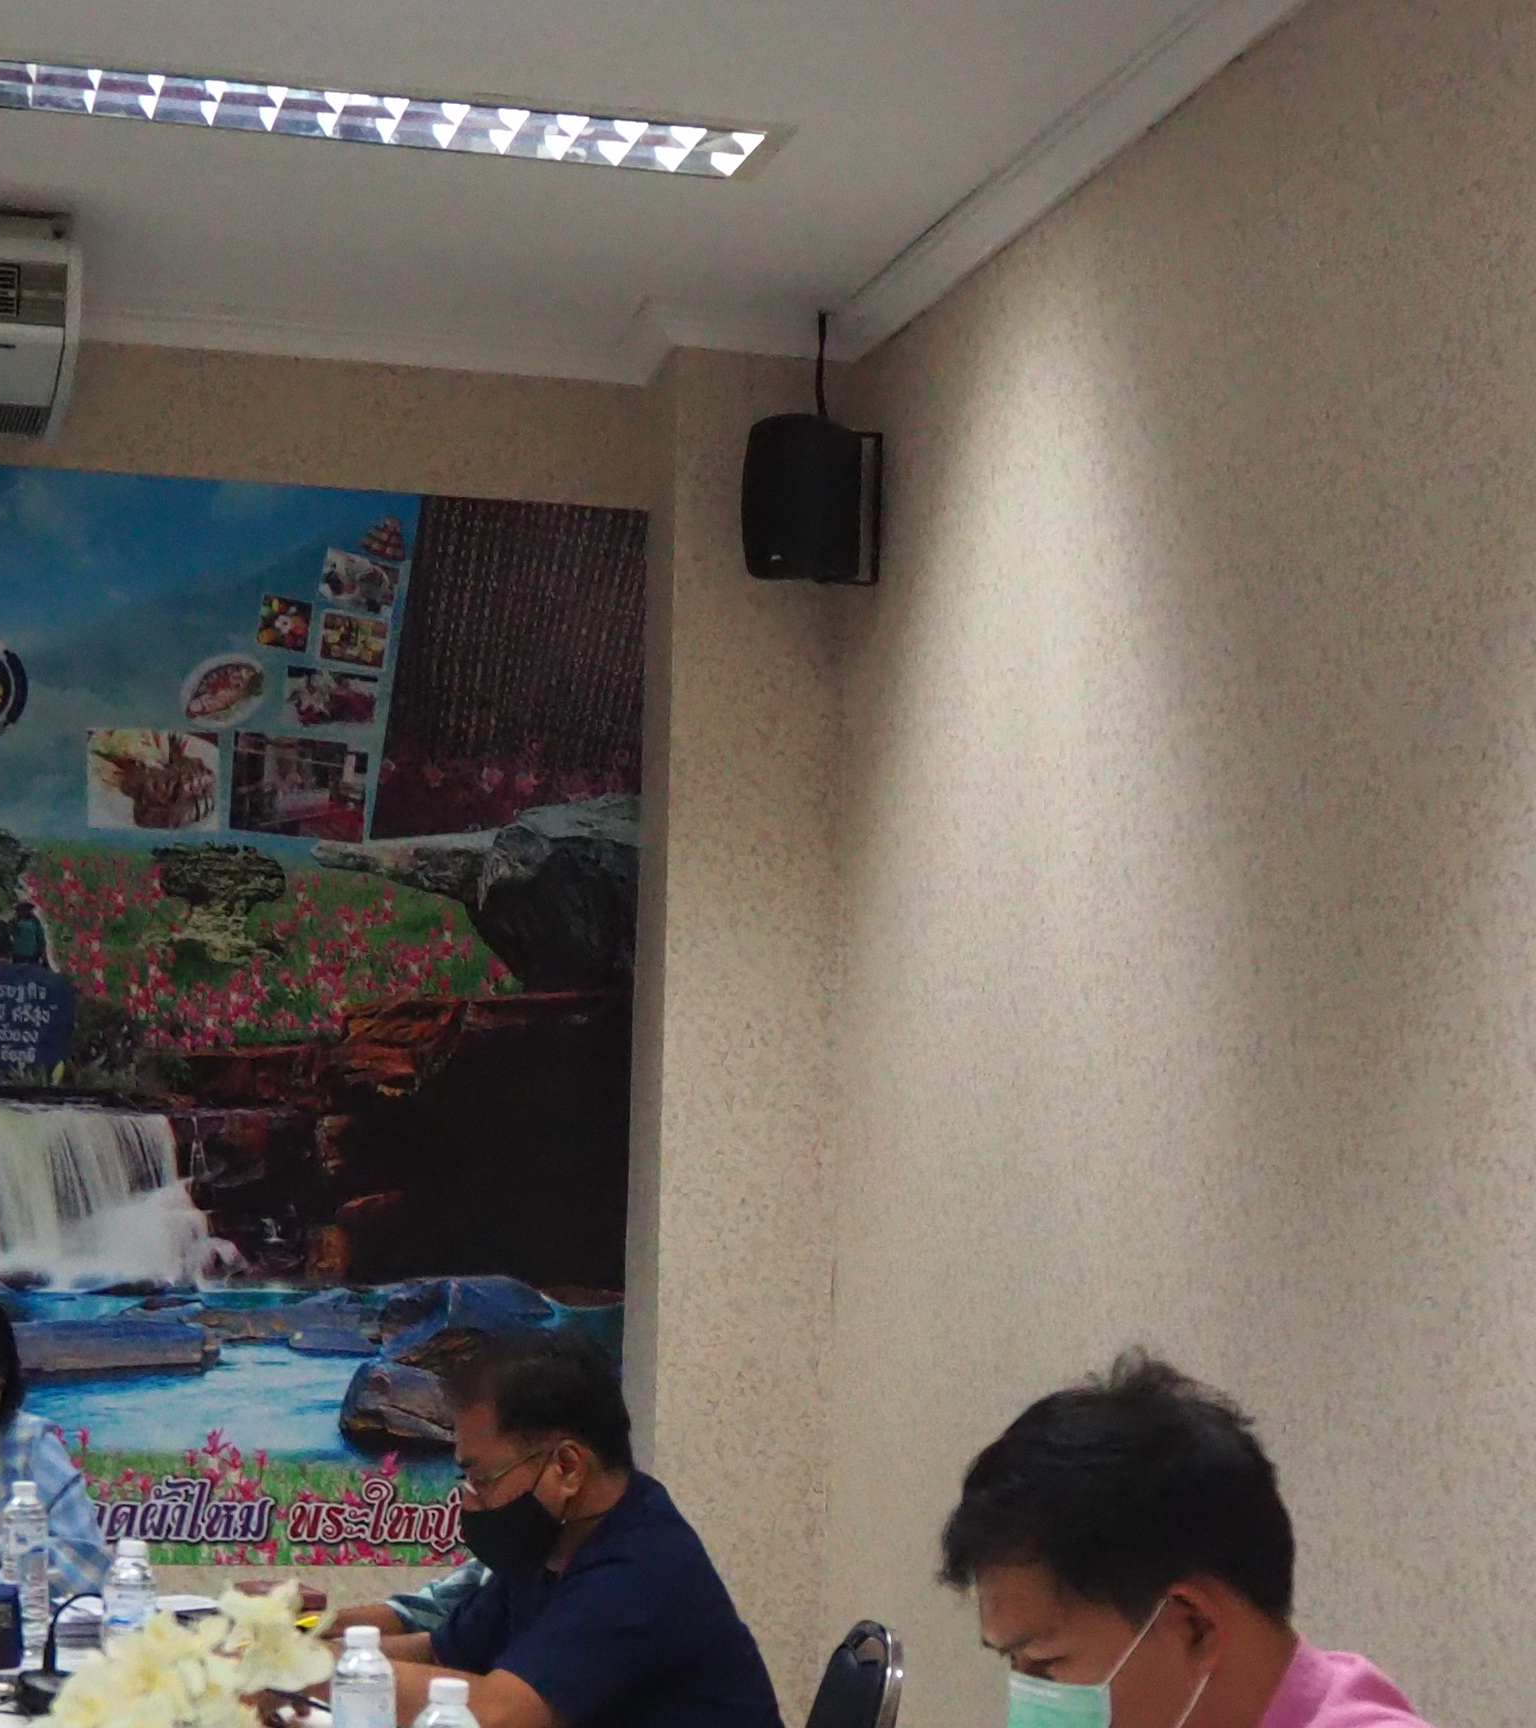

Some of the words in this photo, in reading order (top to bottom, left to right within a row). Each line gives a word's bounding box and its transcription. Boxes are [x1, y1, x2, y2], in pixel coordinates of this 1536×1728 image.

[94, 1475, 273, 1544] ดผ้าไหม
[287, 1477, 464, 1554] พระใหญ่
